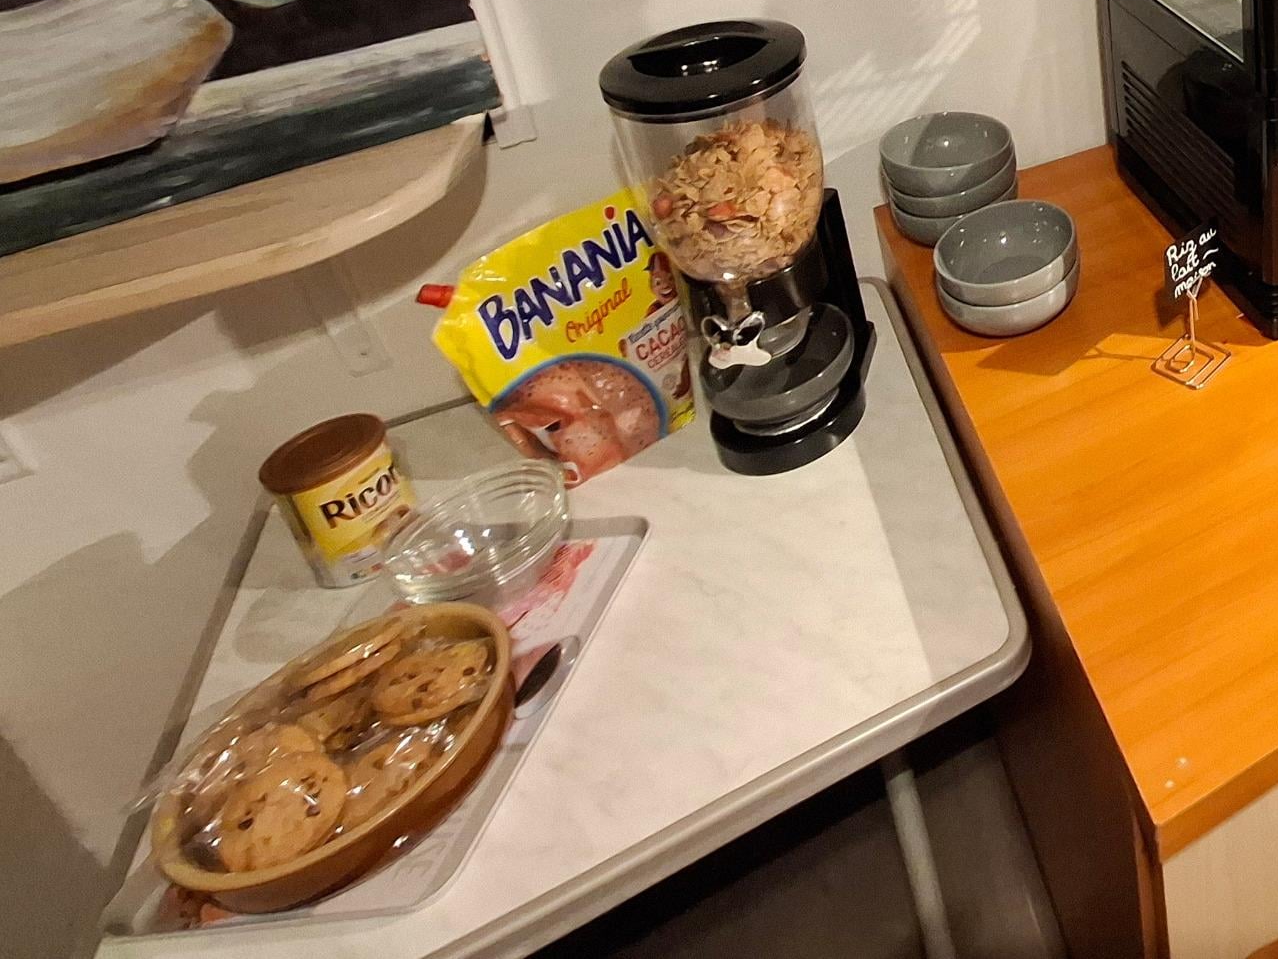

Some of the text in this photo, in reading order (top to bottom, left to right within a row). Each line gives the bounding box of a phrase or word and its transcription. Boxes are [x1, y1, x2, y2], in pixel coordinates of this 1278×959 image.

[1166, 228, 1217, 267] Riz au
[1174, 261, 1217, 299] maison
[477, 206, 655, 360] BANANIA
[566, 277, 632, 343] Original
[319, 461, 400, 529] Ricor
